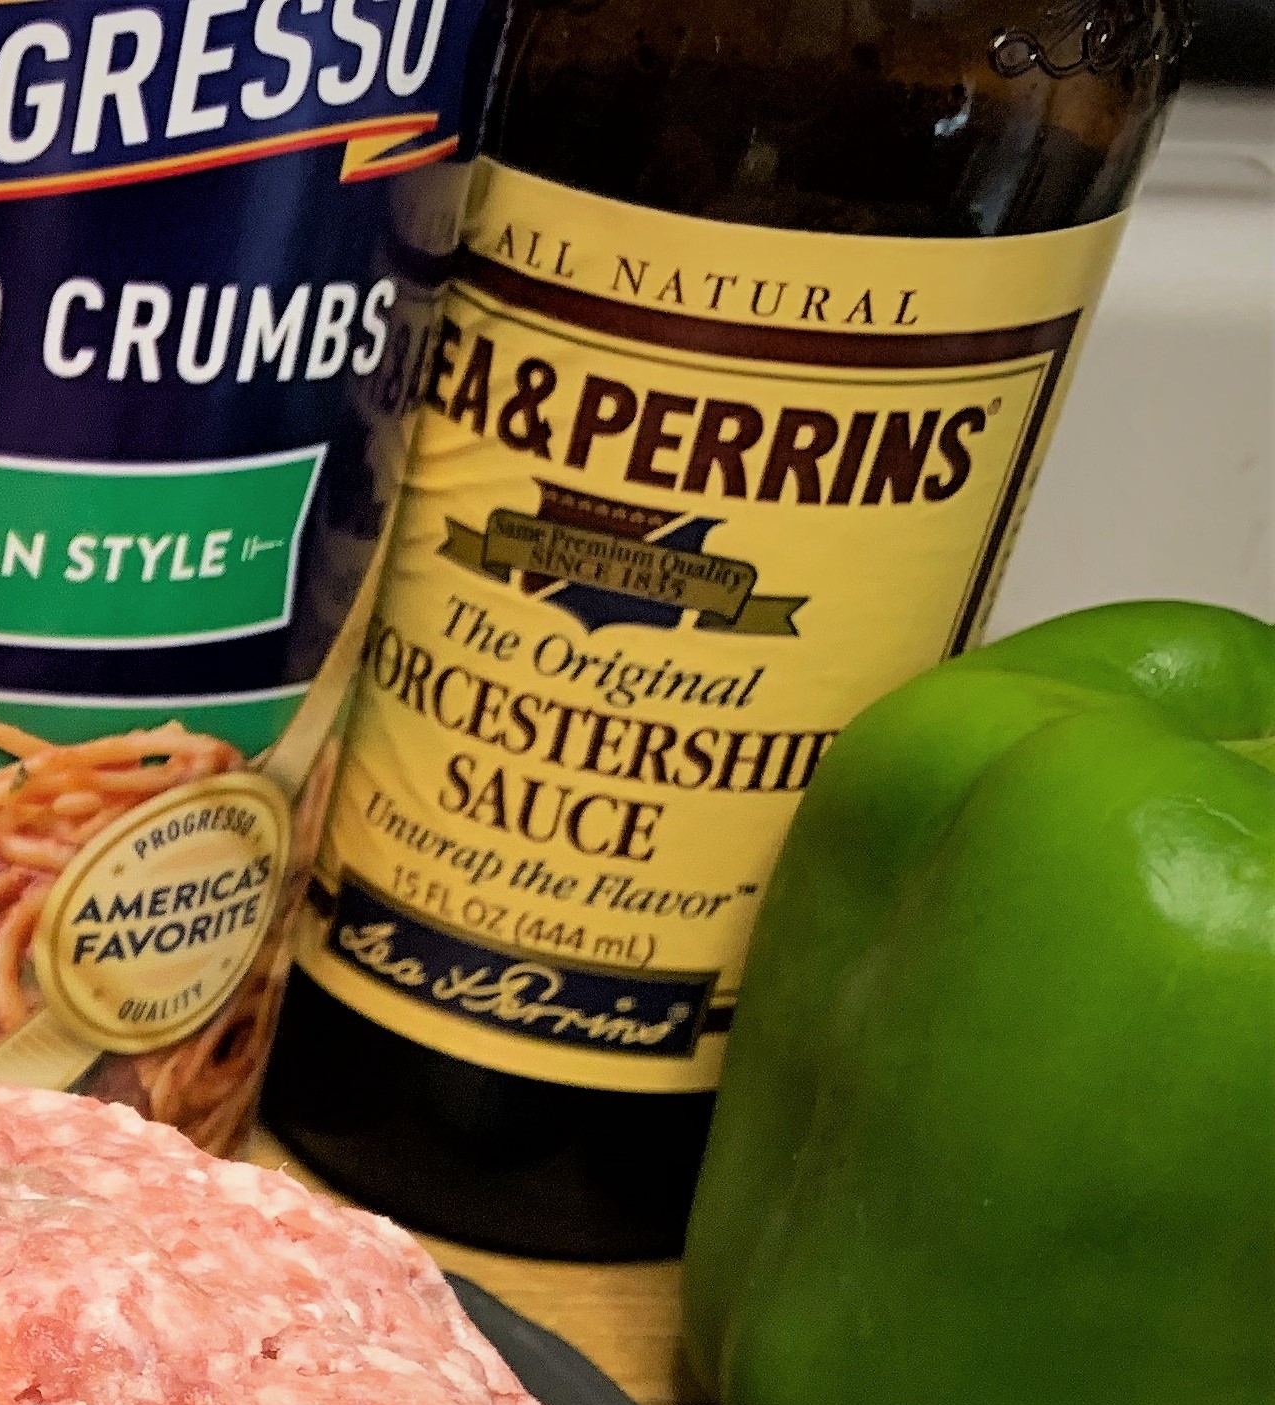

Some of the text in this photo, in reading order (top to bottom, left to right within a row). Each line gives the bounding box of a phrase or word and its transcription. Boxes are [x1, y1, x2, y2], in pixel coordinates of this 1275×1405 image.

[494, 223, 921, 328] ALL NATURAL
[42, 273, 397, 385] CRUMBS
[423, 314, 986, 507] EA&PERRINS
[64, 528, 234, 585] STYLE
[527, 546, 606, 582] SINCE
[549, 522, 654, 568] Premium
[659, 548, 750, 588] Quality
[440, 594, 767, 710] The Original
[361, 613, 841, 794] ORCESTERSHI
[134, 803, 259, 861] PROGRESSO
[363, 790, 503, 887] Unwrap
[508, 858, 580, 902] the
[437, 751, 666, 862] SAUCE
[71, 894, 261, 966] FAVORITE
[389, 865, 418, 898] 15
[423, 883, 452, 915] FL
[462, 896, 509, 937] OZ
[514, 911, 585, 953] (444
[117, 983, 205, 1025] QUALITY
